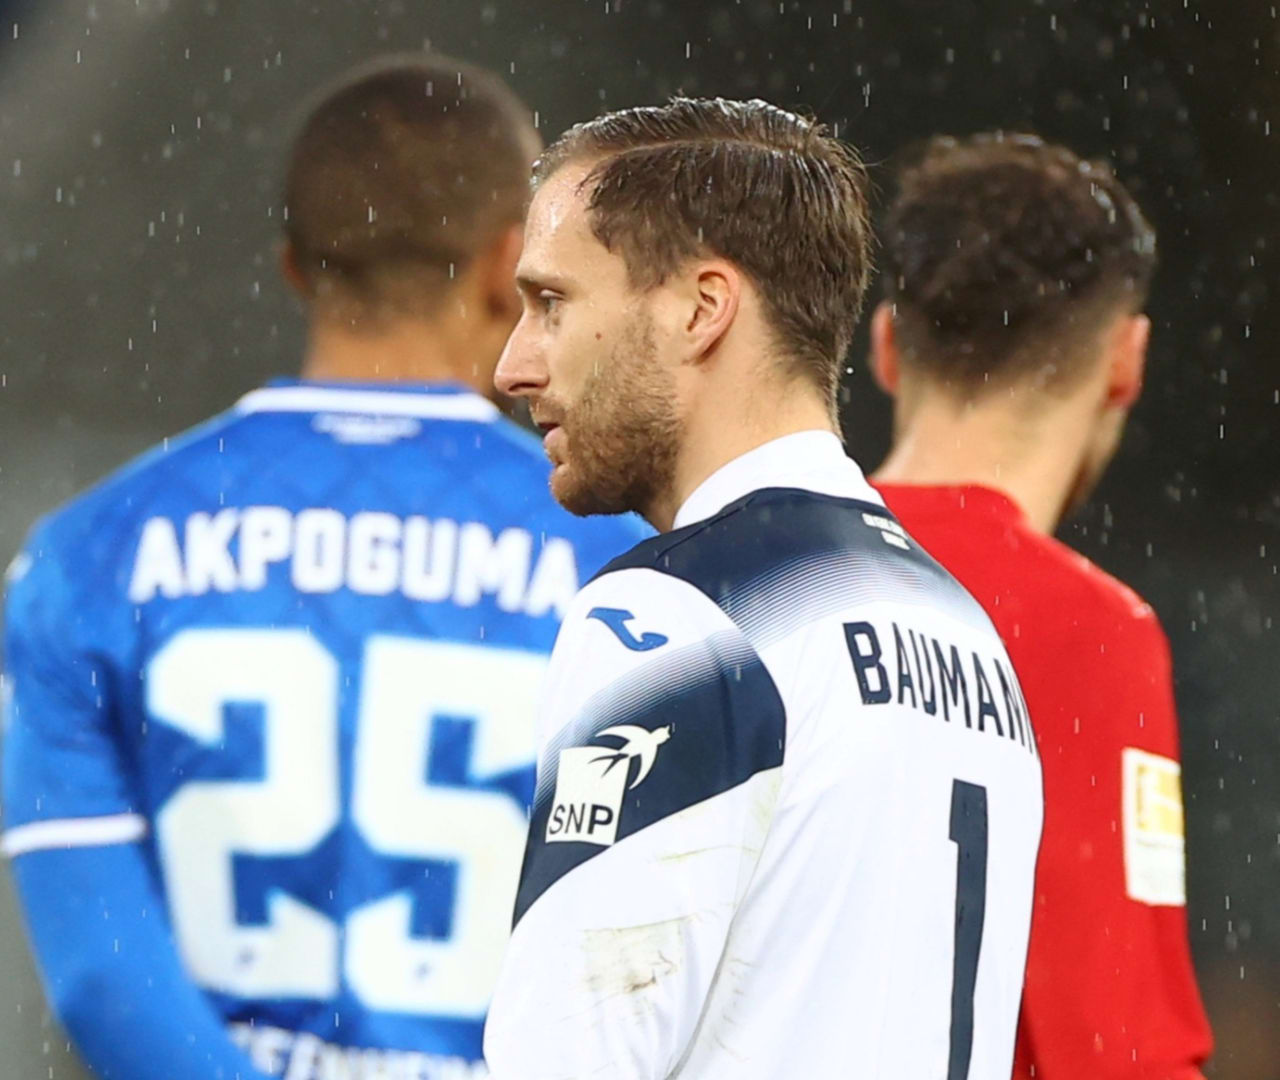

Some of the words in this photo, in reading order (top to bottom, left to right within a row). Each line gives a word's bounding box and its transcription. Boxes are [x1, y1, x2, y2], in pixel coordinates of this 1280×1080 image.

[127, 505, 579, 617] AKPOGUMA
[145, 626, 554, 1021] 25
[549, 802, 614, 835] SNP
